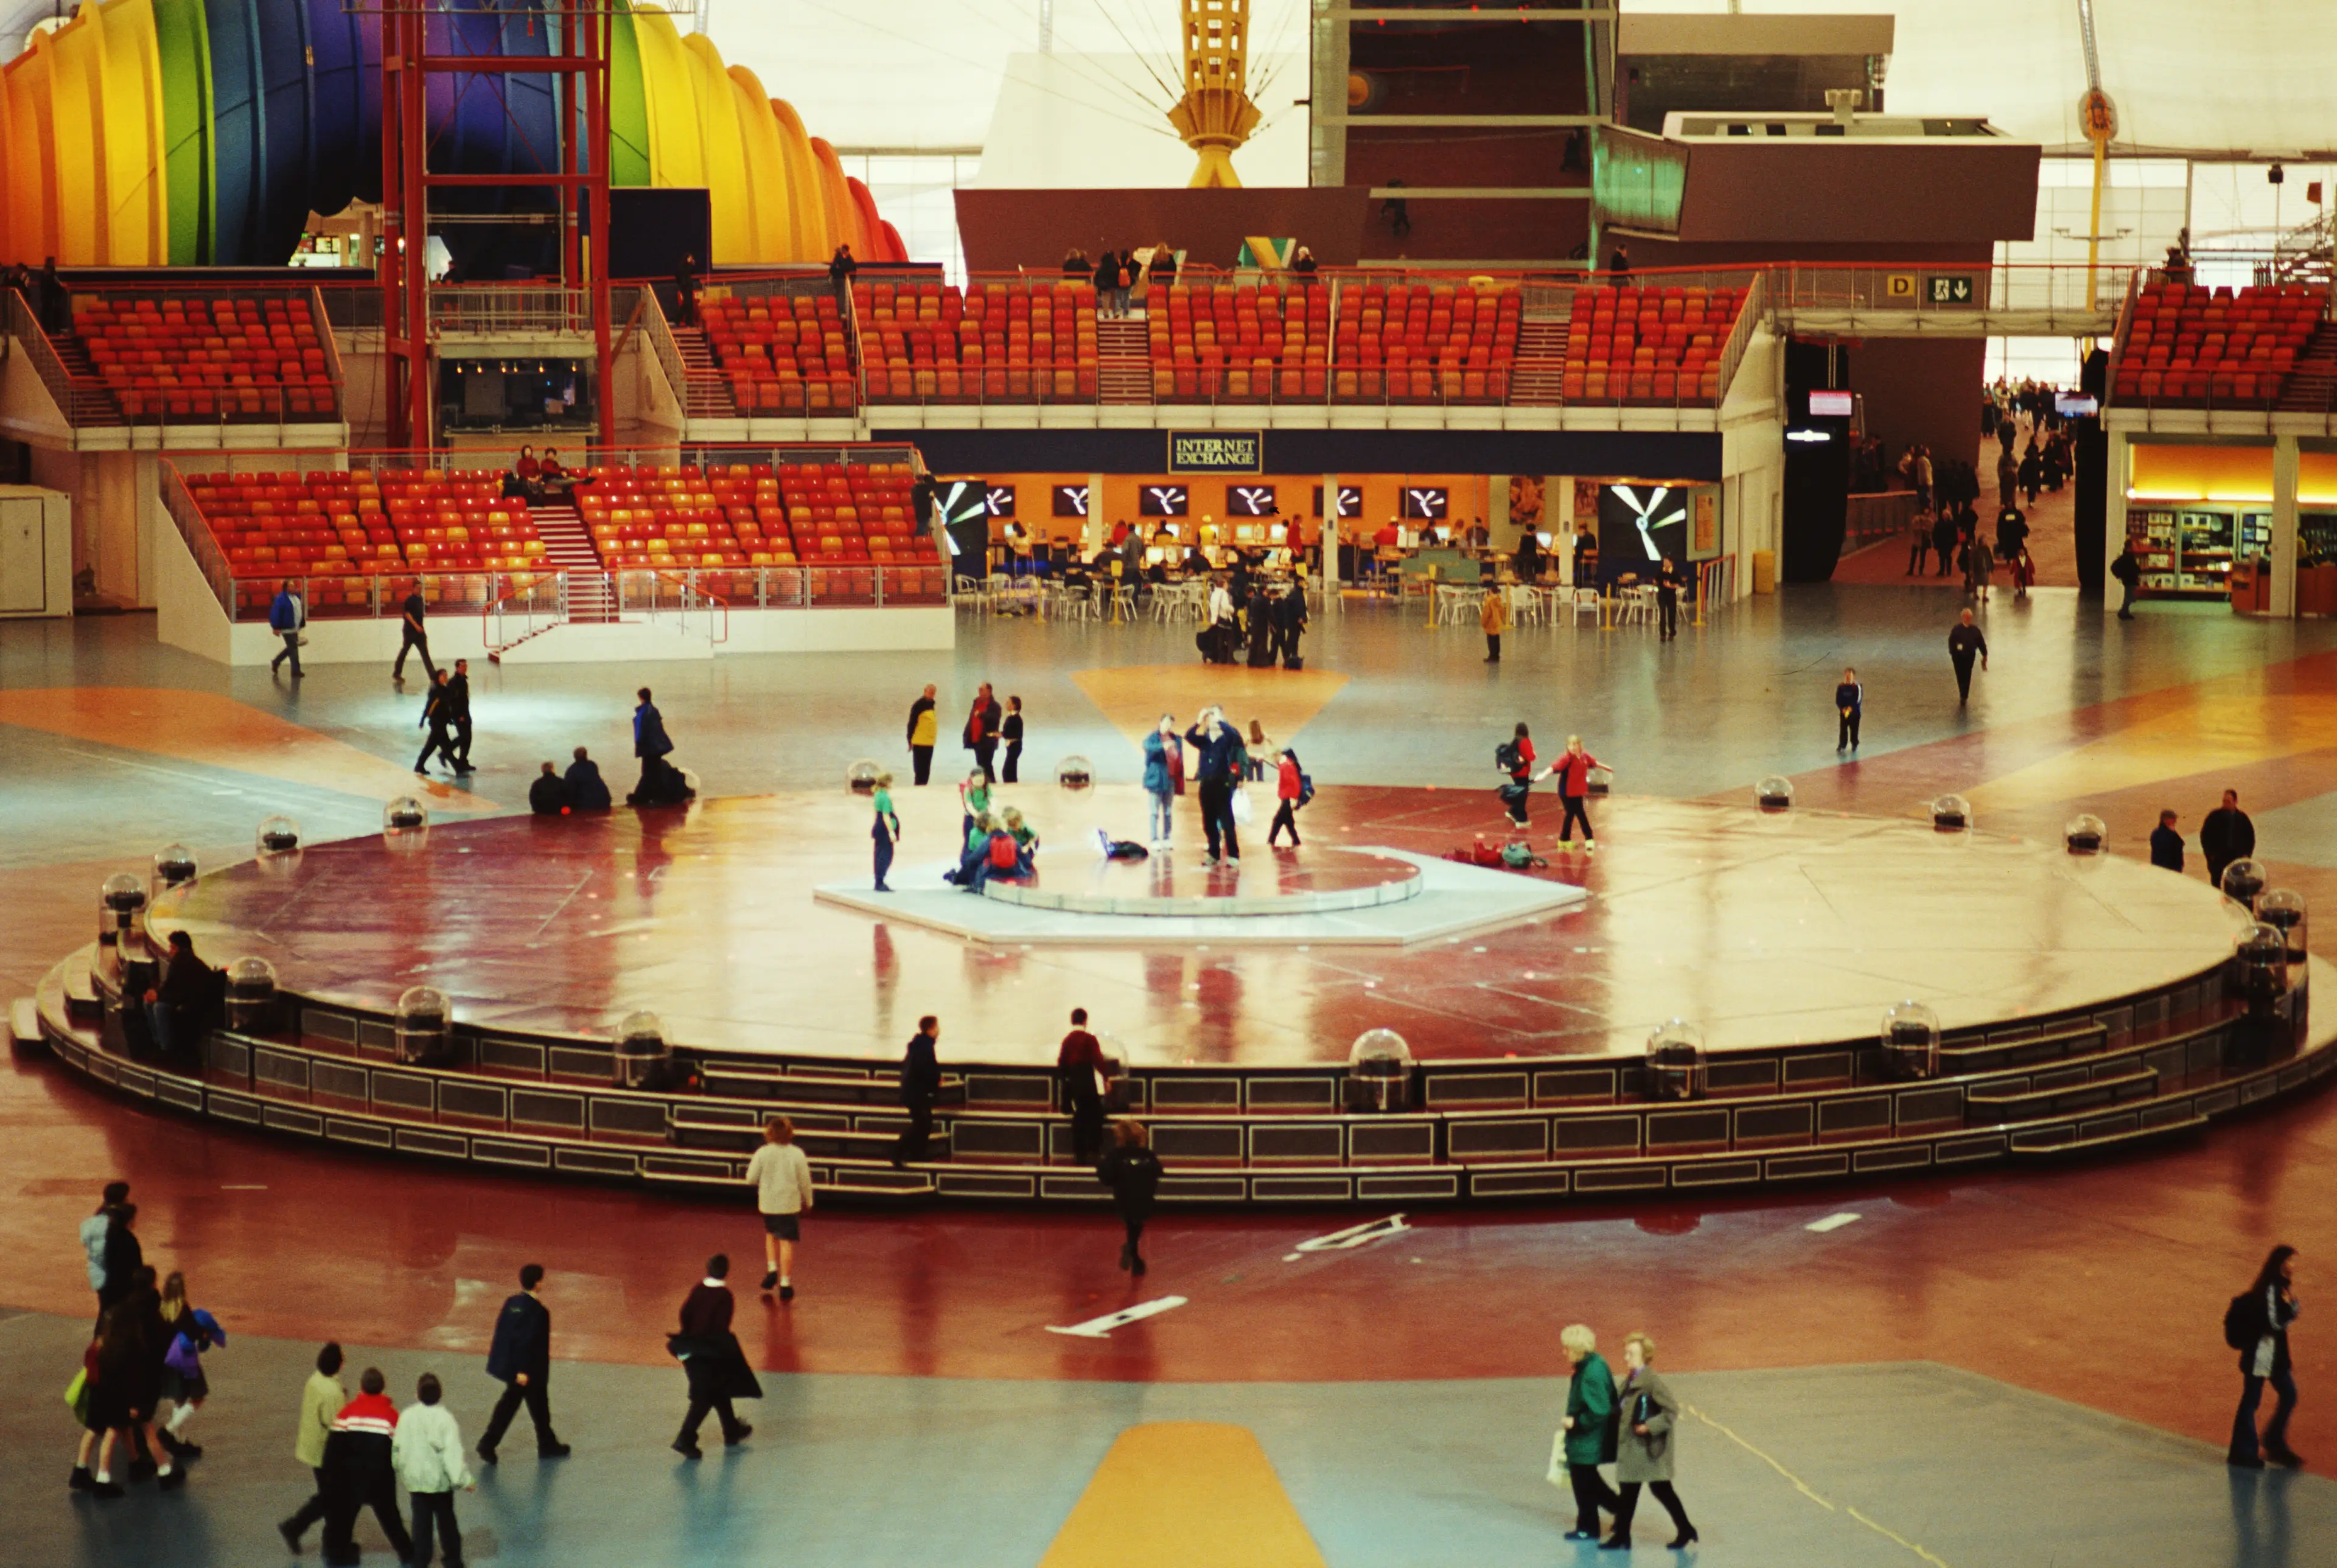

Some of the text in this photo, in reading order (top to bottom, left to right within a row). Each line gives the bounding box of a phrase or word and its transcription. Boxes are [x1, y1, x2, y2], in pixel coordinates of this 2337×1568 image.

[1894, 278, 1908, 293] D
[1176, 439, 1255, 451] INTERNET
[1176, 452, 1254, 464] EXCHANGE
